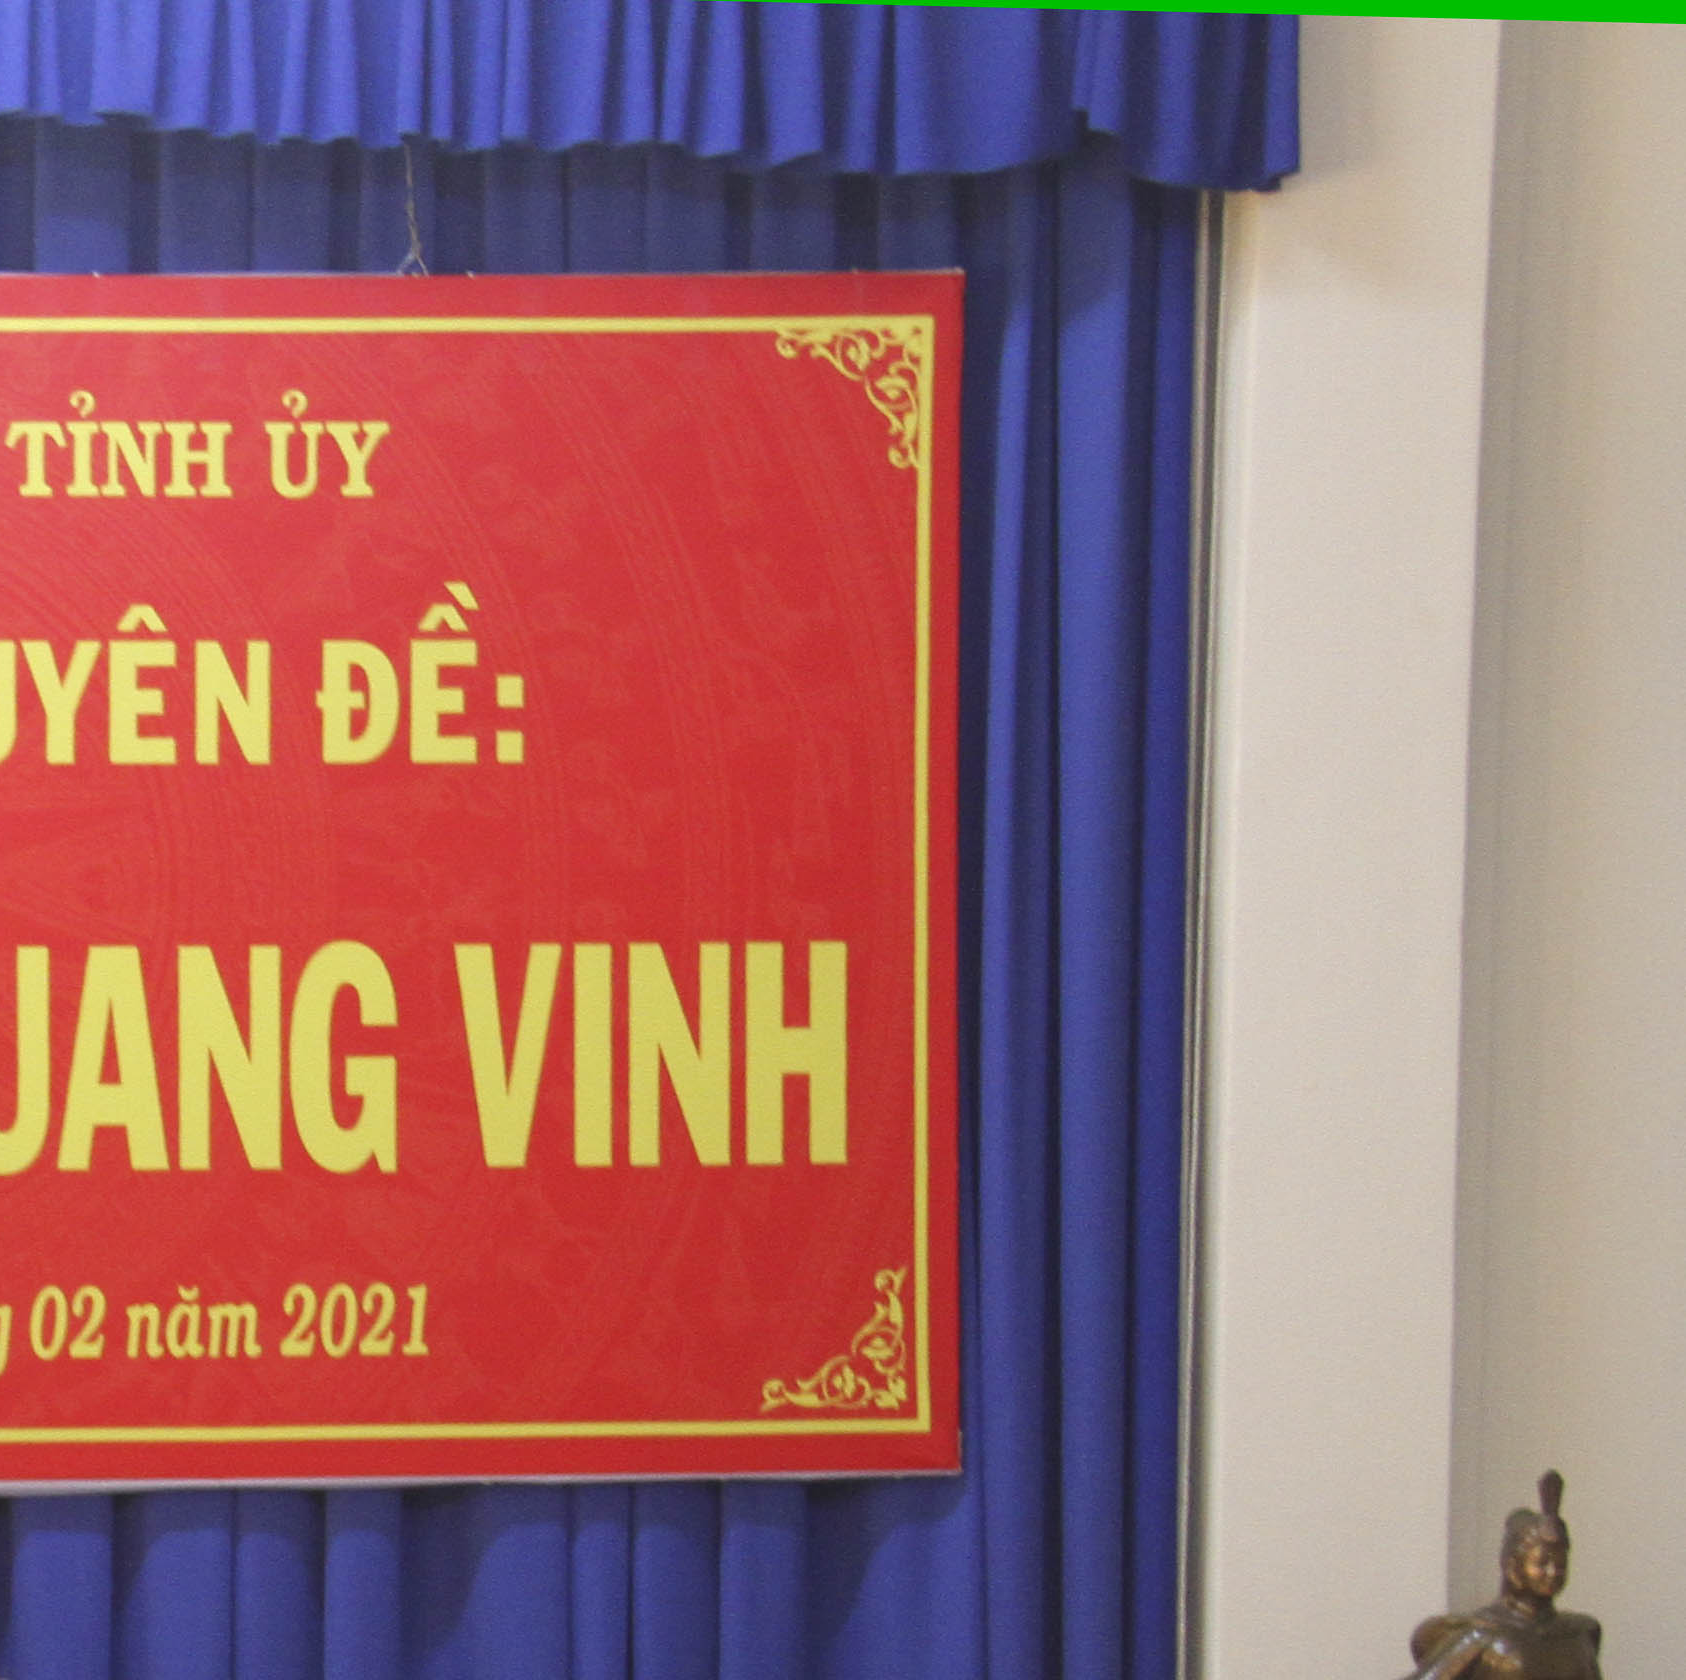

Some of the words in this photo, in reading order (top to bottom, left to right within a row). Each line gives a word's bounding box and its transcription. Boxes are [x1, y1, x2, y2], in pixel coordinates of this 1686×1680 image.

[4, 390, 234, 498] TỈNH
[264, 389, 391, 499] ỦY
[315, 581, 525, 765] ĐỀ:
[454, 941, 848, 1168] VINH
[29, 1285, 107, 1360] 02
[126, 1285, 262, 1358] năm
[280, 1282, 429, 1358] 2021
